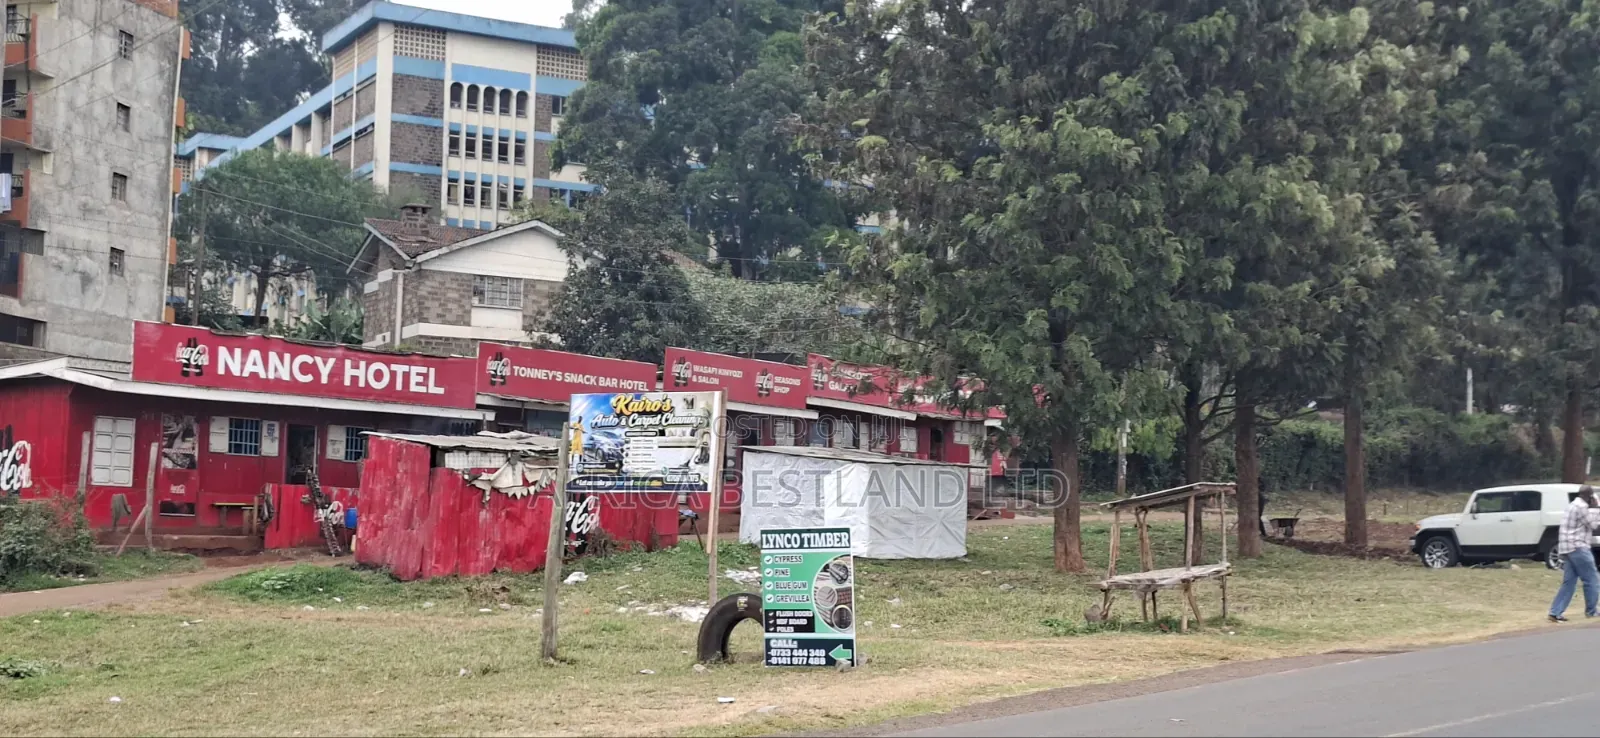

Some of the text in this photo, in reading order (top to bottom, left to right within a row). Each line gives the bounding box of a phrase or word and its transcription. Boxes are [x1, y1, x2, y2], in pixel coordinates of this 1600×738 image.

[217, 346, 445, 395] NANCY HOTEL
[693, 364, 743, 378] WASAFI KINYOZI
[513, 365, 650, 392] TONNEY'S SNACK BAR HOTEL
[697, 375, 719, 385] SALON
[773, 385, 790, 394] SHOP
[612, 394, 673, 415] Kairo's
[591, 414, 619, 428] Auto
[620, 418, 627, 426] &
[628, 413, 660, 430] Carpet
[762, 532, 850, 549] LYNCO TIMBER
[774, 555, 802, 563] CYPRESS
[793, 581, 807, 589] GUM
[769, 639, 798, 648] CALL:
